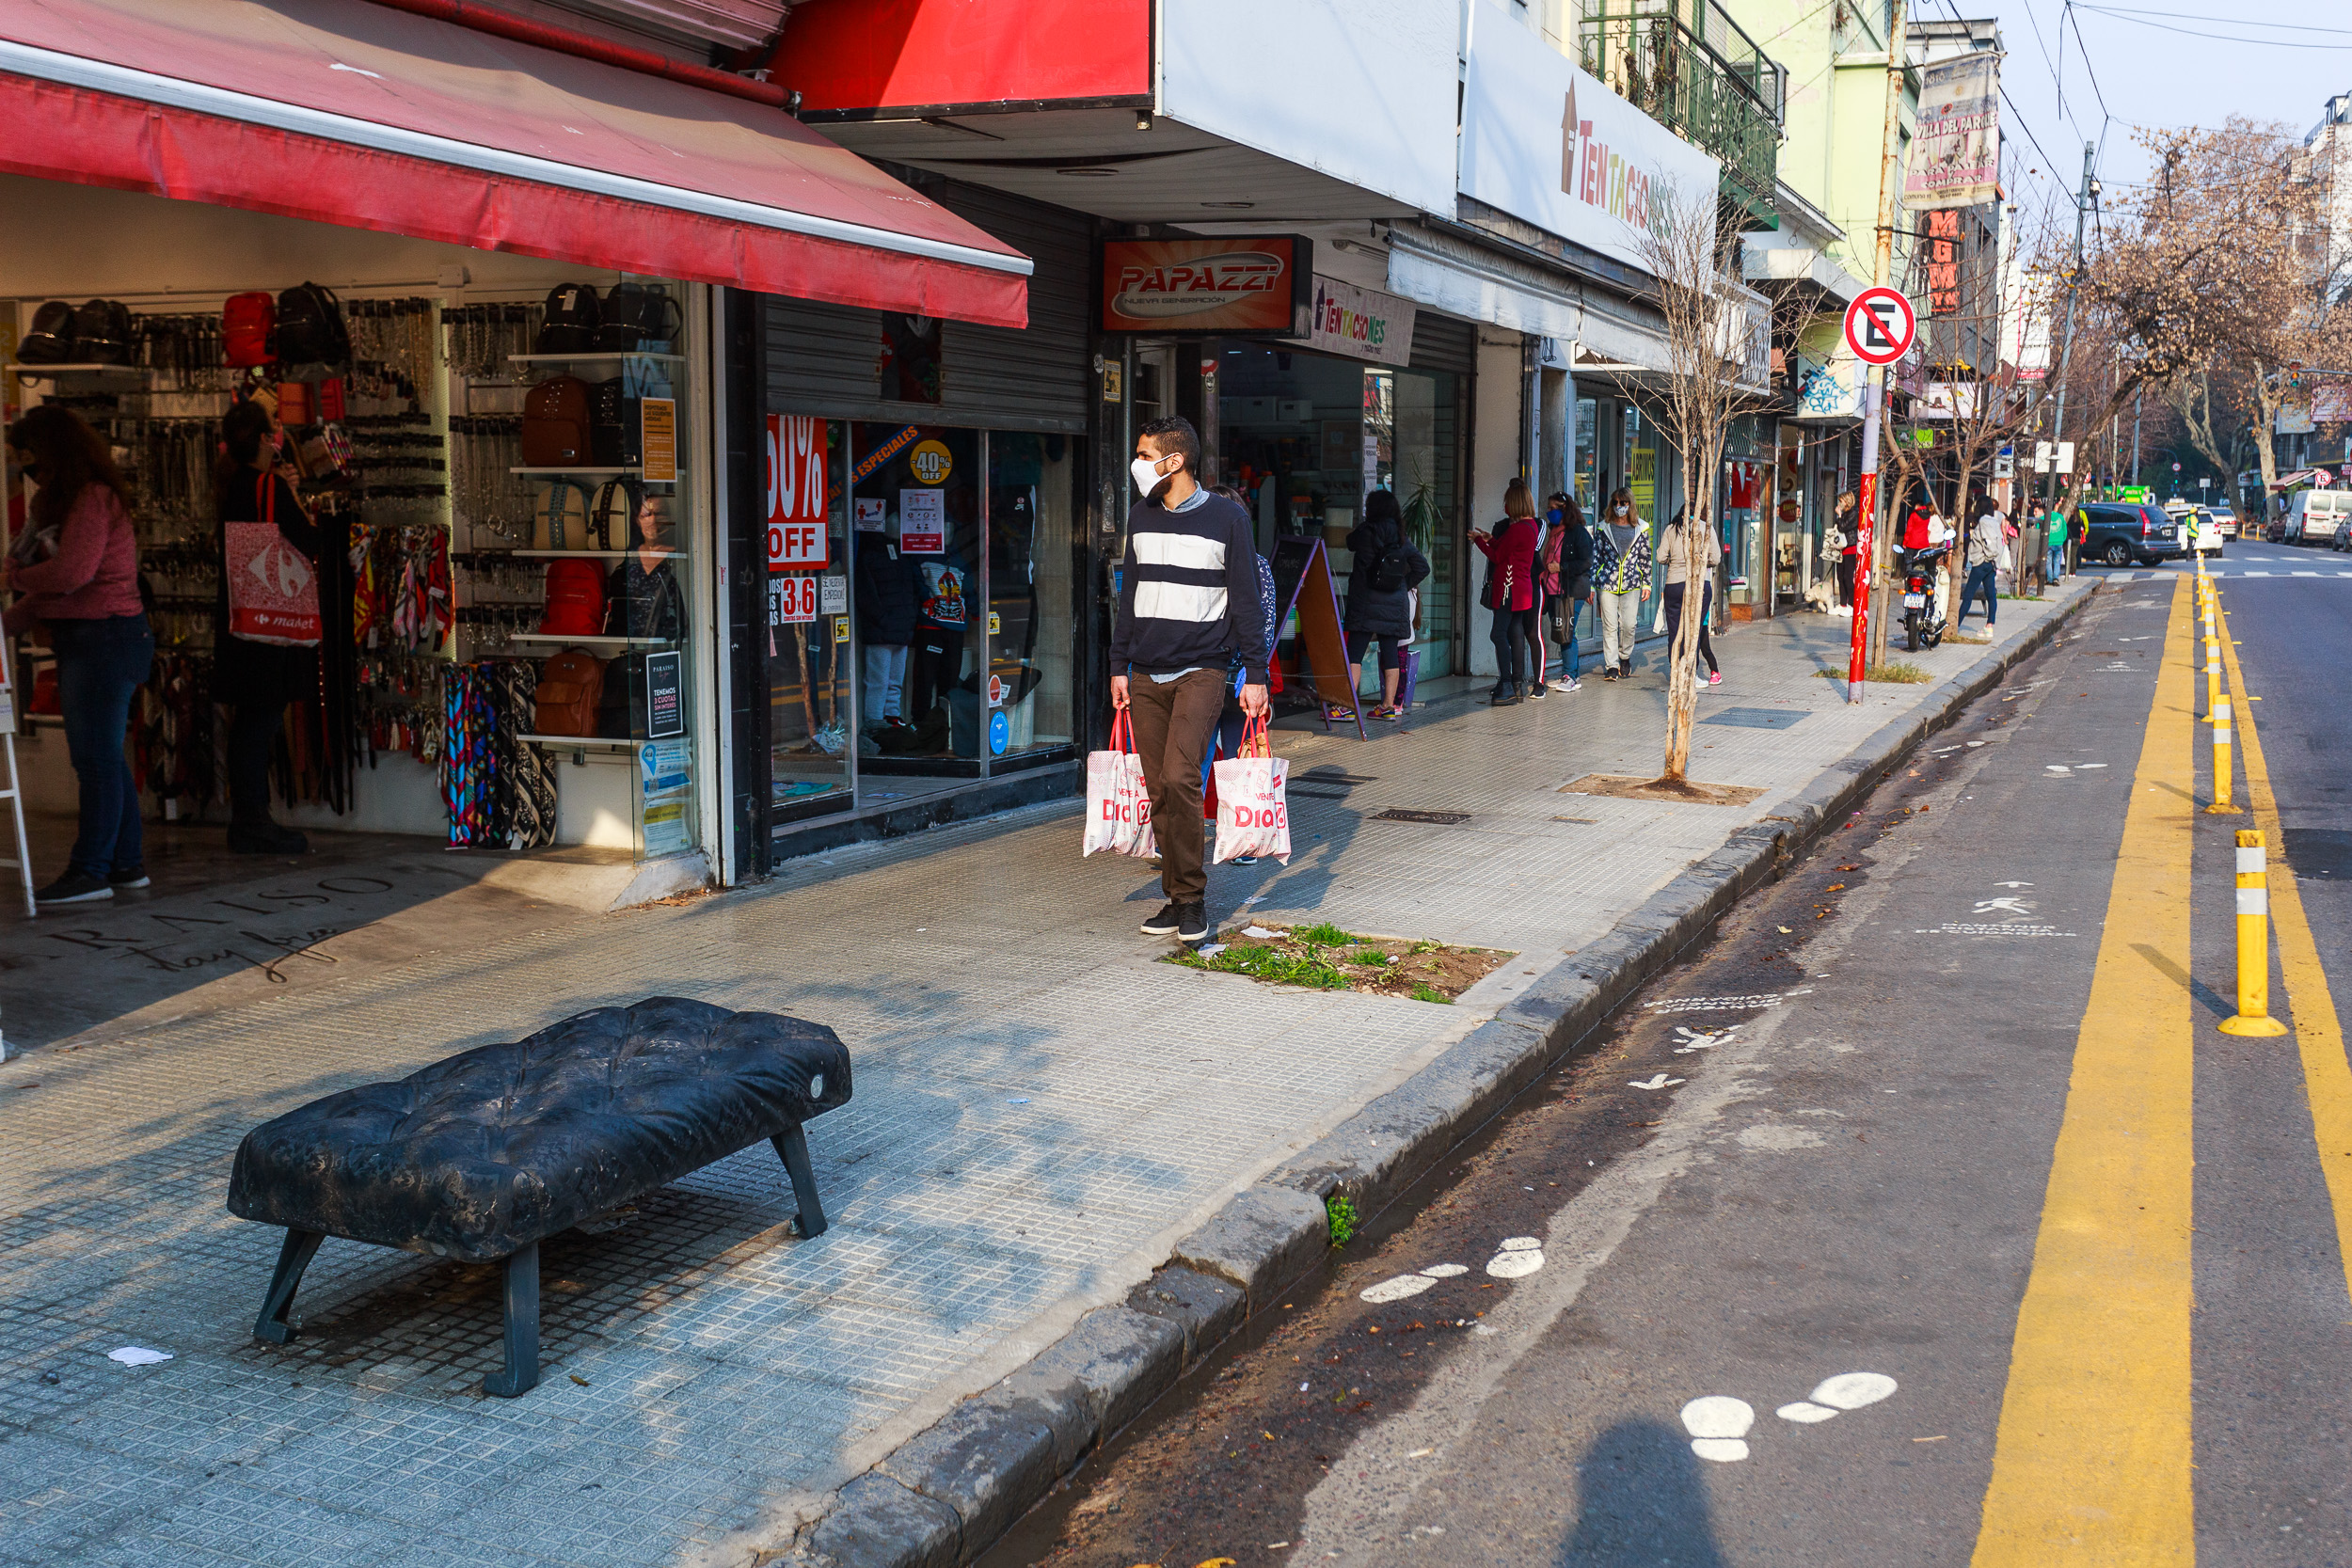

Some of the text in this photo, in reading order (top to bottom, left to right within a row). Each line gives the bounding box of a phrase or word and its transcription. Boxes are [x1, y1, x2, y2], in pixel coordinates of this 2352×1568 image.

[1915, 121, 1941, 139] VILLA
[1943, 119, 1959, 135] DEL
[1911, 166, 1945, 177] PARA
[1921, 174, 1982, 189] COMPRAR
[856, 425, 919, 477] ESPECIALES
[1632, 452, 1655, 481] ABRIMOS
[769, 528, 816, 559] OFF
[783, 578, 796, 615] 3
[802, 578, 815, 615] 6
[273, 616, 314, 629] market
[653, 664, 675, 673] PARAISO
[654, 687, 675, 697] TENEMOS
[658, 694, 676, 704] CUOTAS
